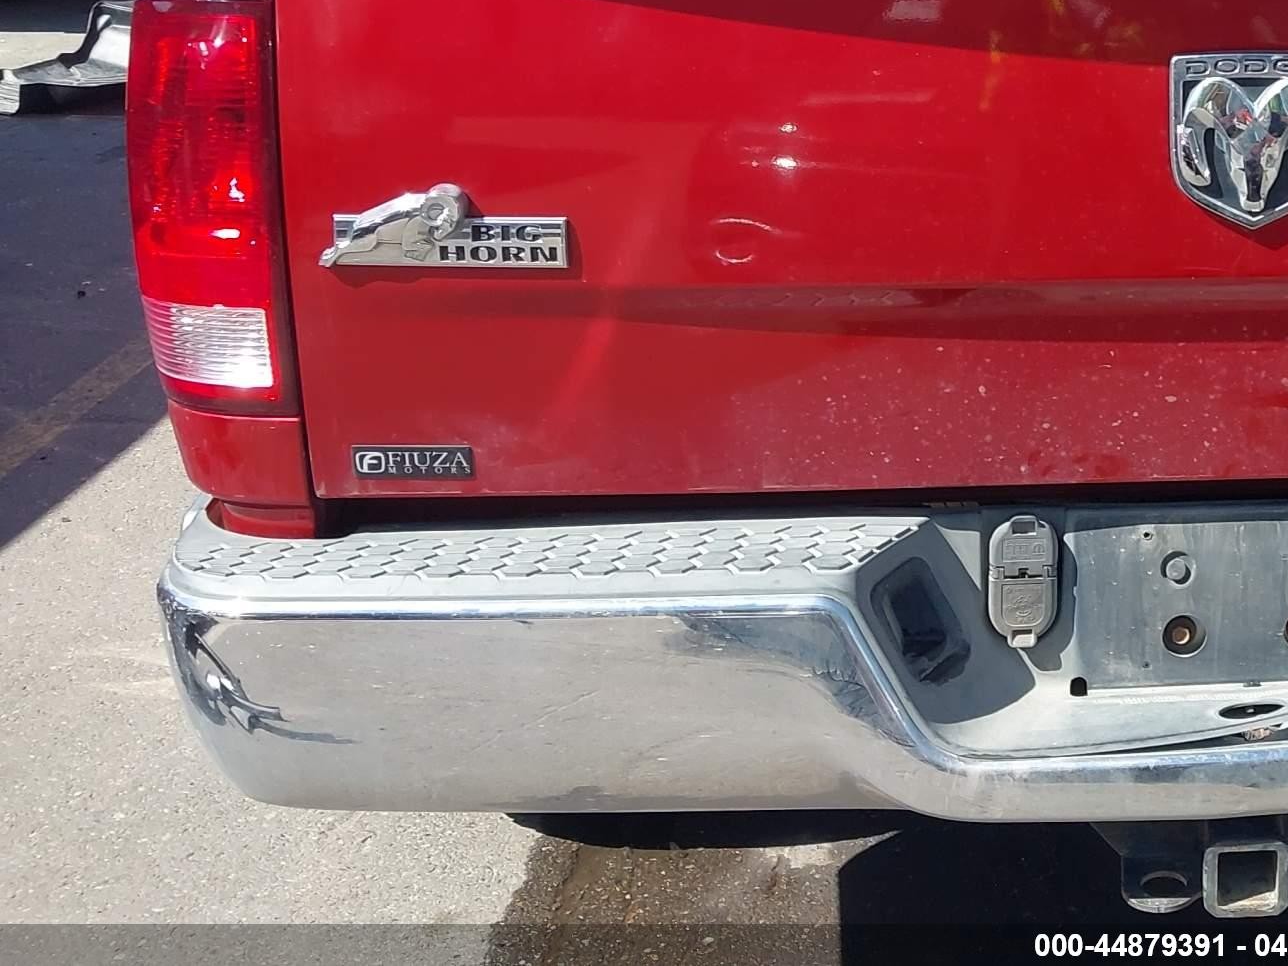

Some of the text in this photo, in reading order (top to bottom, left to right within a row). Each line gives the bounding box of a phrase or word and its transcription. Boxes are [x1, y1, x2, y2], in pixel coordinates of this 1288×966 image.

[471, 224, 543, 242] BIG
[439, 245, 558, 263] HORN
[386, 451, 469, 467] FIUZA
[388, 466, 471, 474] MOTORS
